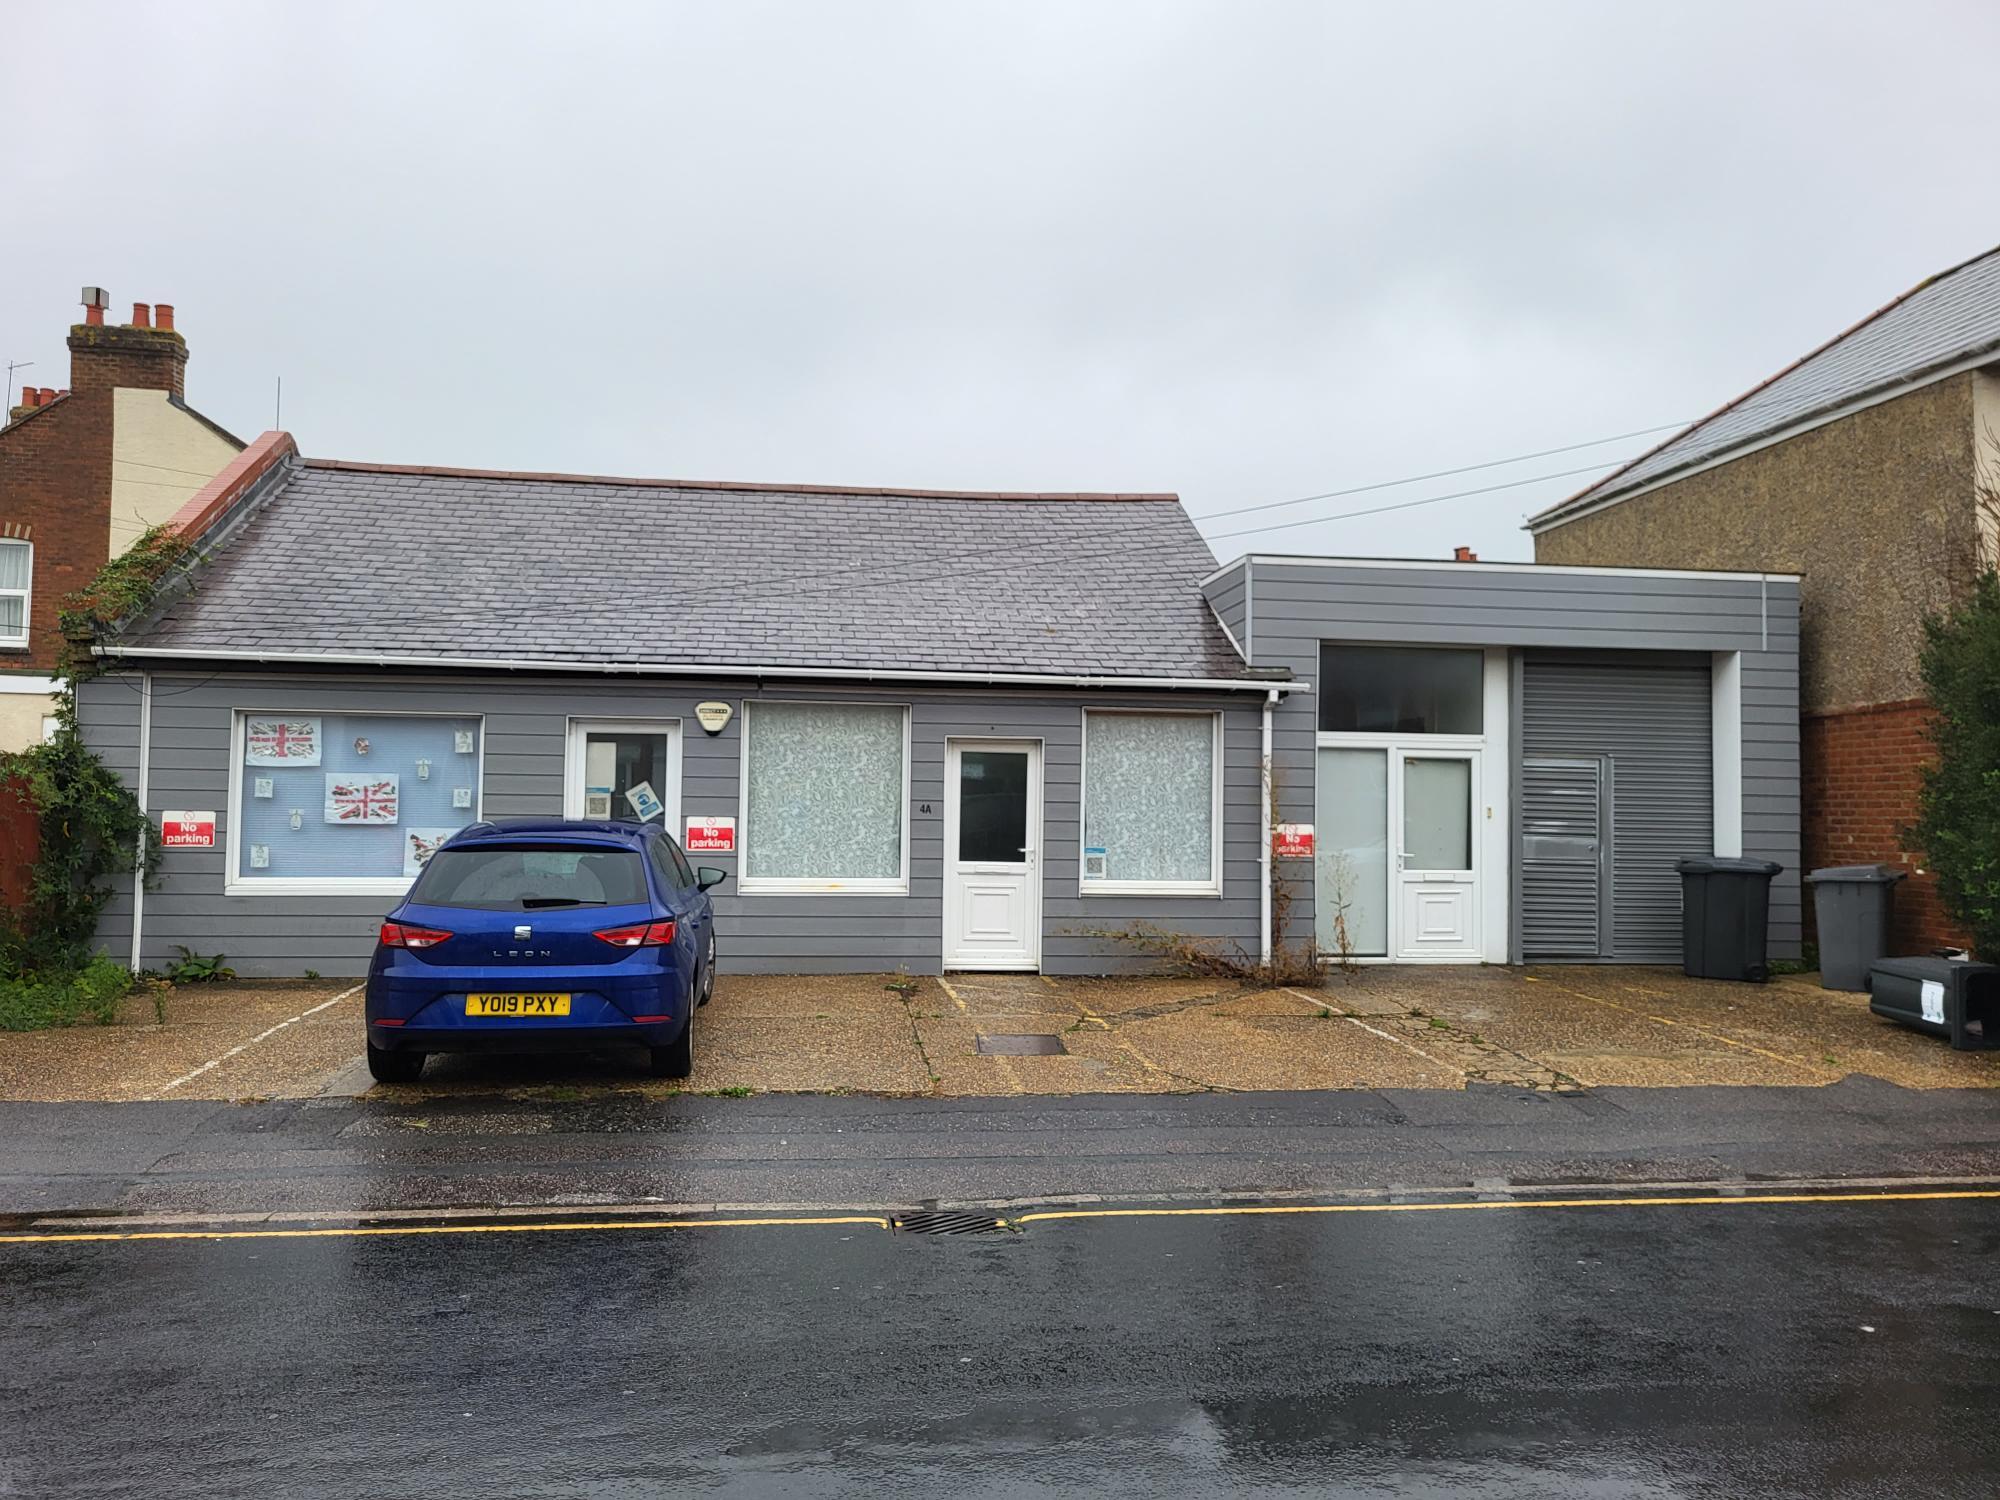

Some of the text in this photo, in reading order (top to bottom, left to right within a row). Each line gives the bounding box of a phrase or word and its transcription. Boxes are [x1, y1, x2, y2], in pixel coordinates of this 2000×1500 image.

[920, 804, 931, 814] 4A
[181, 822, 197, 832] No
[703, 827, 719, 837] No
[166, 834, 210, 845] parking
[1286, 833, 1300, 843] No
[690, 838, 731, 849] parking
[479, 996, 559, 1012] YO19 PXY
